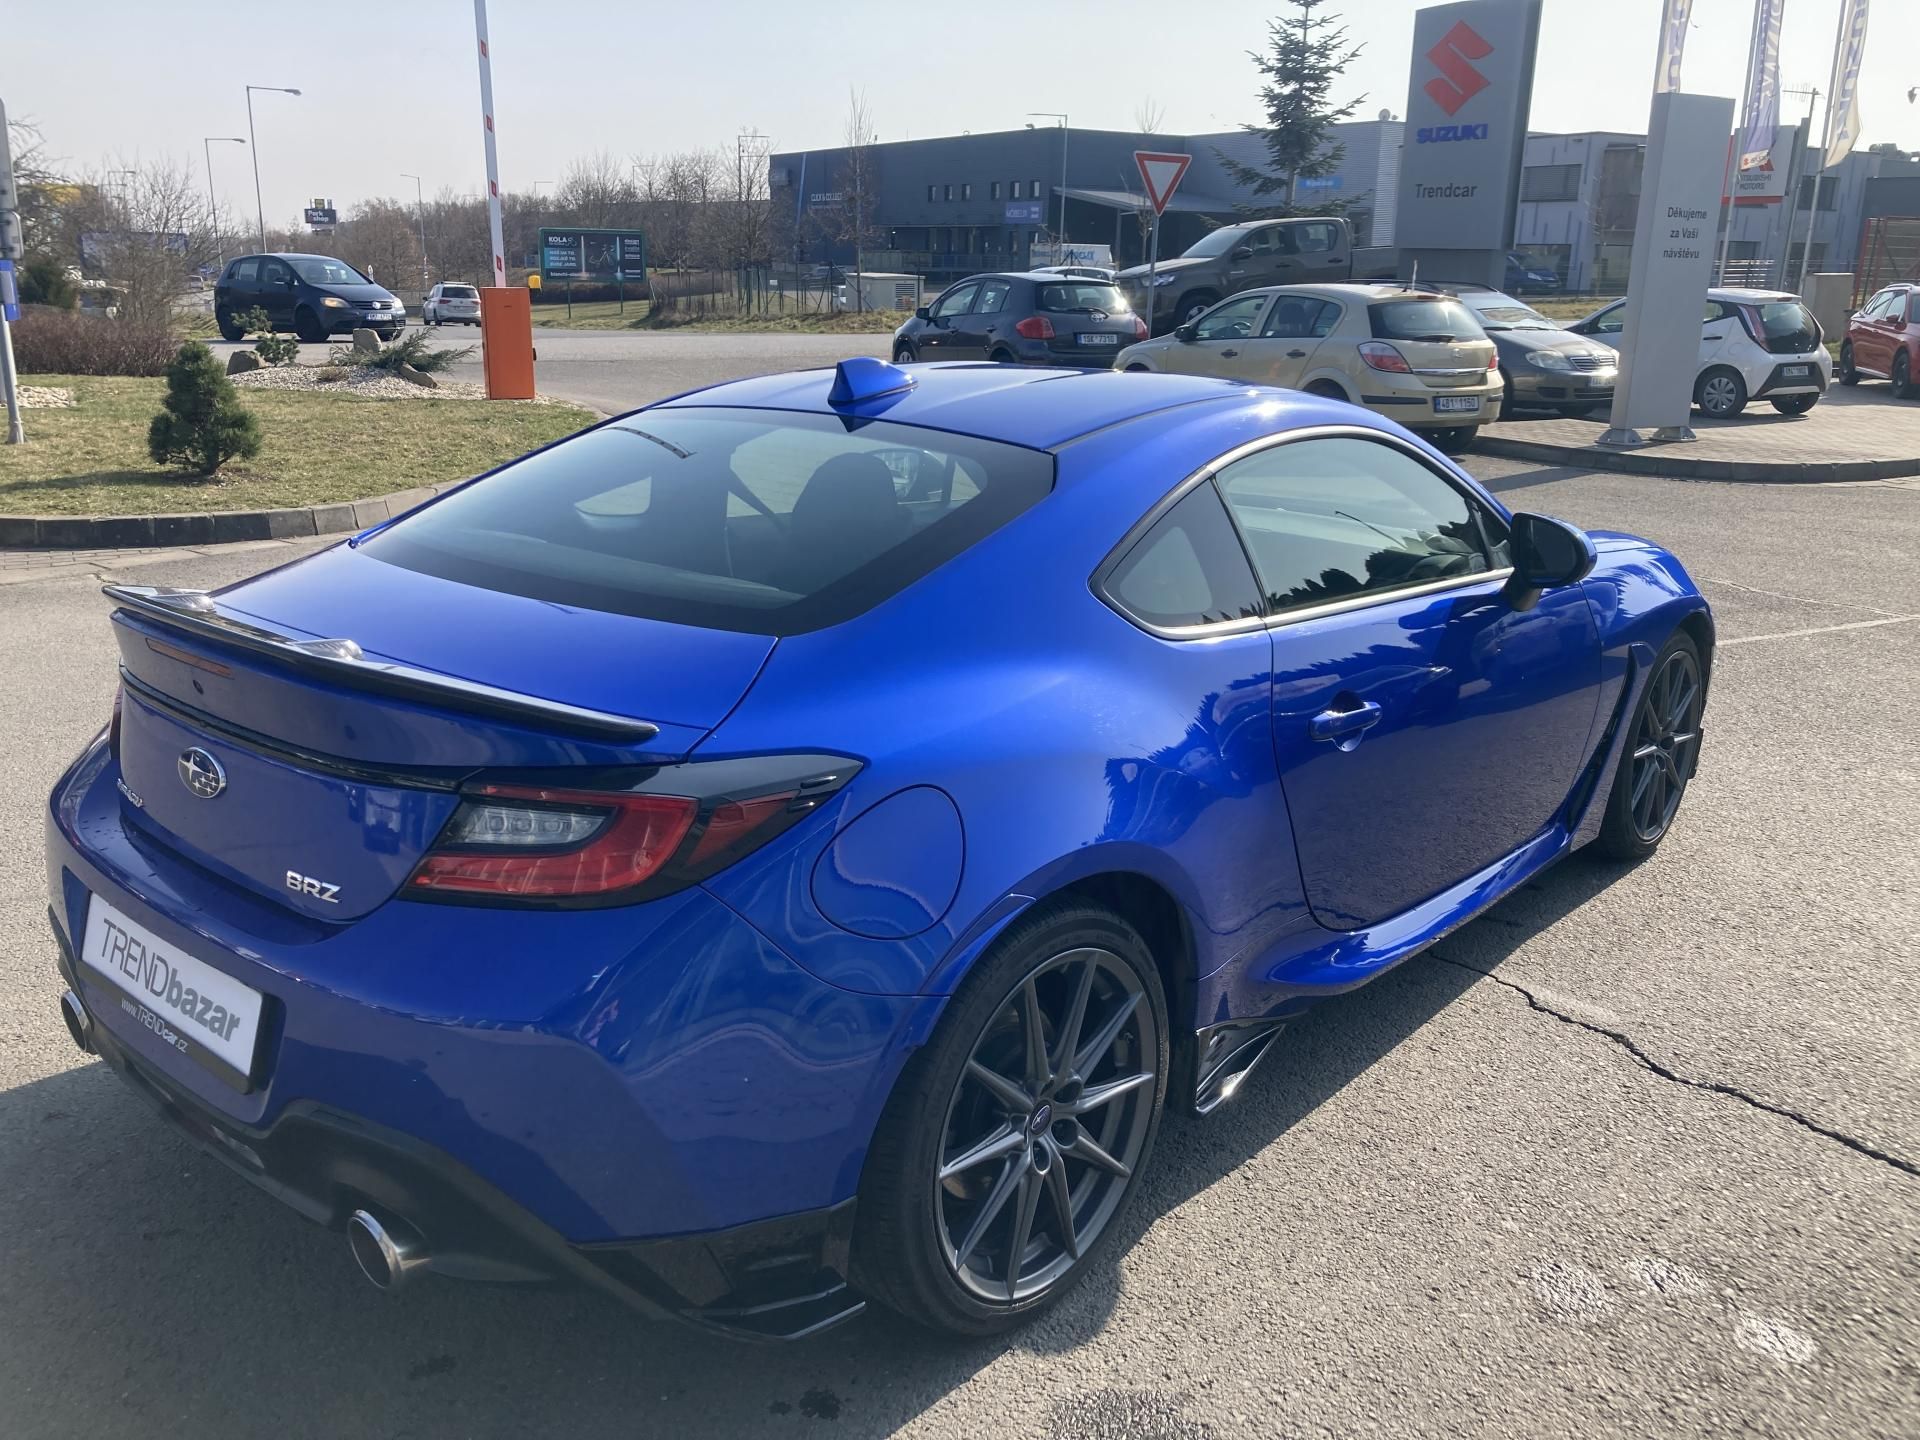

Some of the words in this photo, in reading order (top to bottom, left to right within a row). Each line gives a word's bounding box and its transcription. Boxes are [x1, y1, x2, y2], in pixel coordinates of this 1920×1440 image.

[1416, 123, 1489, 144] SUZUKI
[1415, 182, 1478, 198] Trendcar
[1740, 182, 1765, 190] MOTORS
[1667, 206, 1707, 221] Děkujeme
[1670, 230, 1680, 238] za
[1663, 248, 1700, 259] návštěvu
[286, 870, 342, 904] BRZ
[101, 918, 241, 1042] TRENDbazar
[121, 998, 189, 1053] www.TRENDcar.cz
